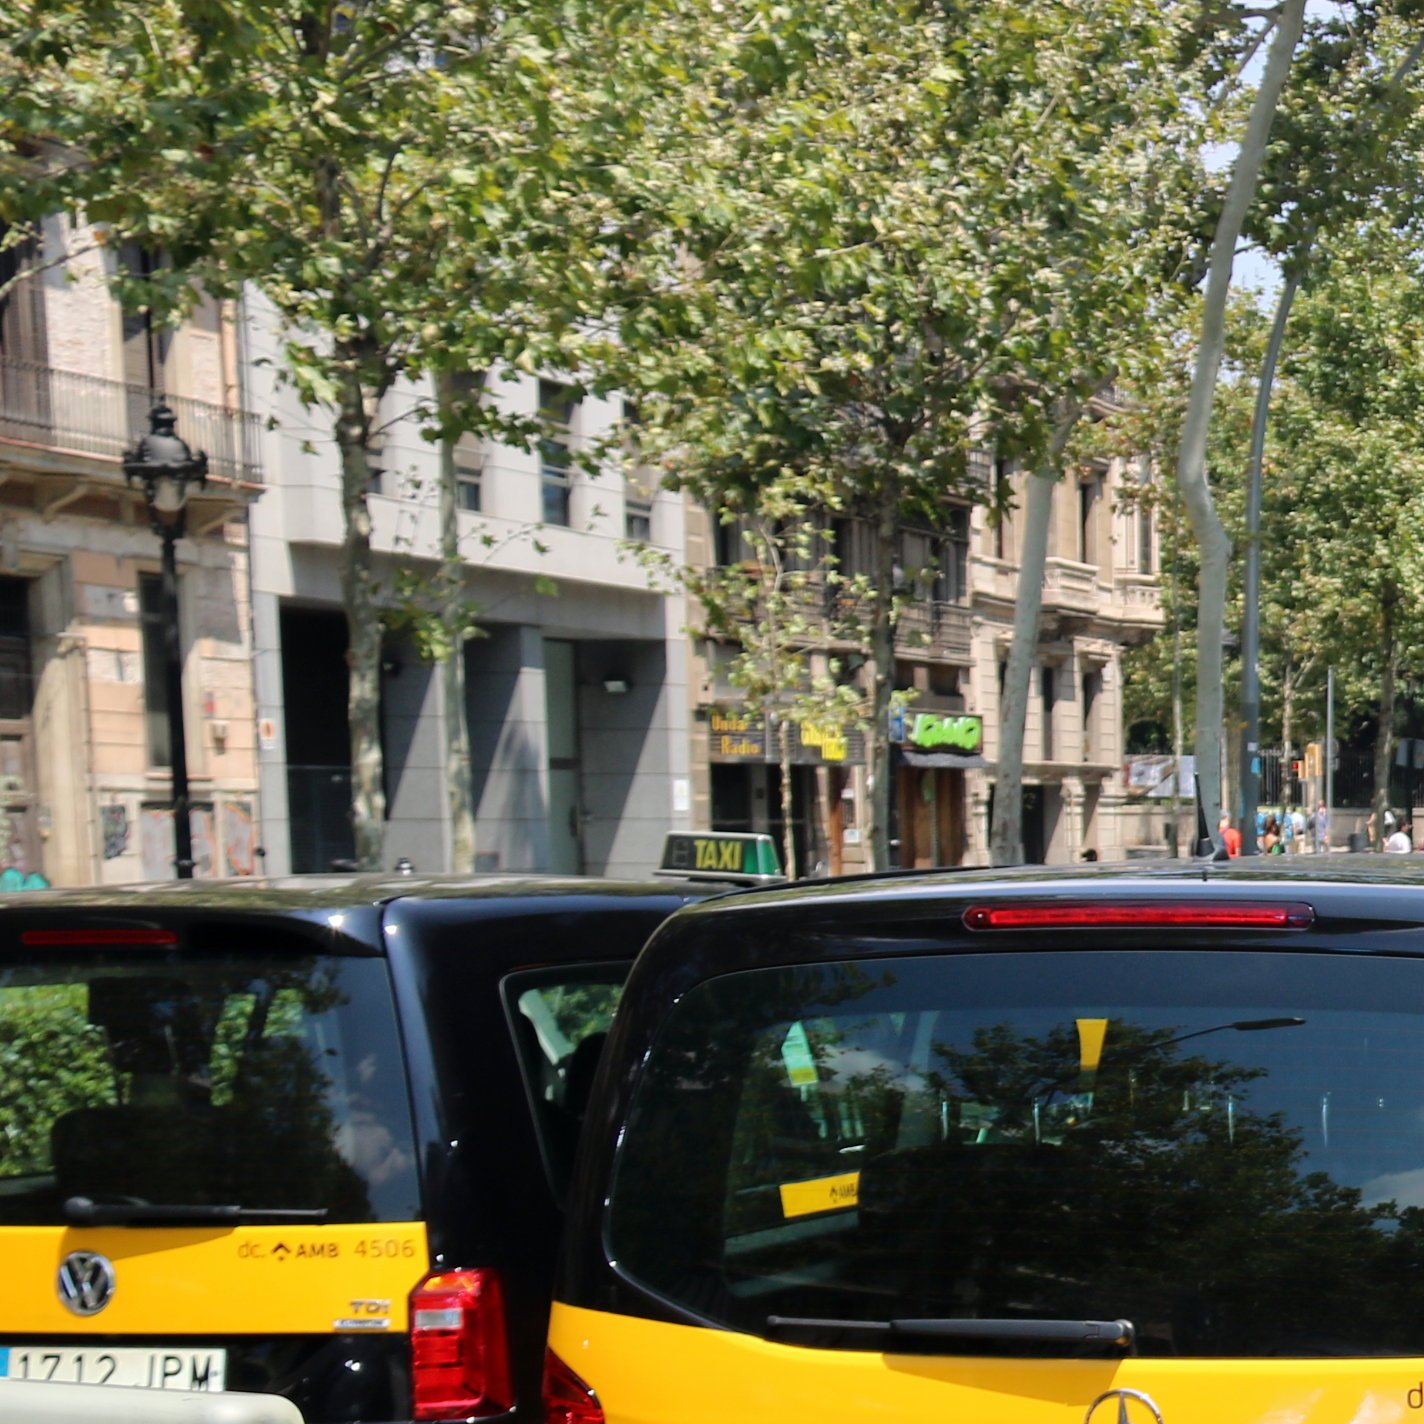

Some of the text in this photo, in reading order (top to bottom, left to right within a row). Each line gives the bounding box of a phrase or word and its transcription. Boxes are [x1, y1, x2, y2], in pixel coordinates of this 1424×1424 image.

[721, 735, 760, 754] Radio
[693, 839, 742, 870] TAXI
[296, 1242, 339, 1259] AMB
[354, 1239, 416, 1259] 4506
[350, 1299, 391, 1314] TDI
[18, 1353, 117, 1384] 1712
